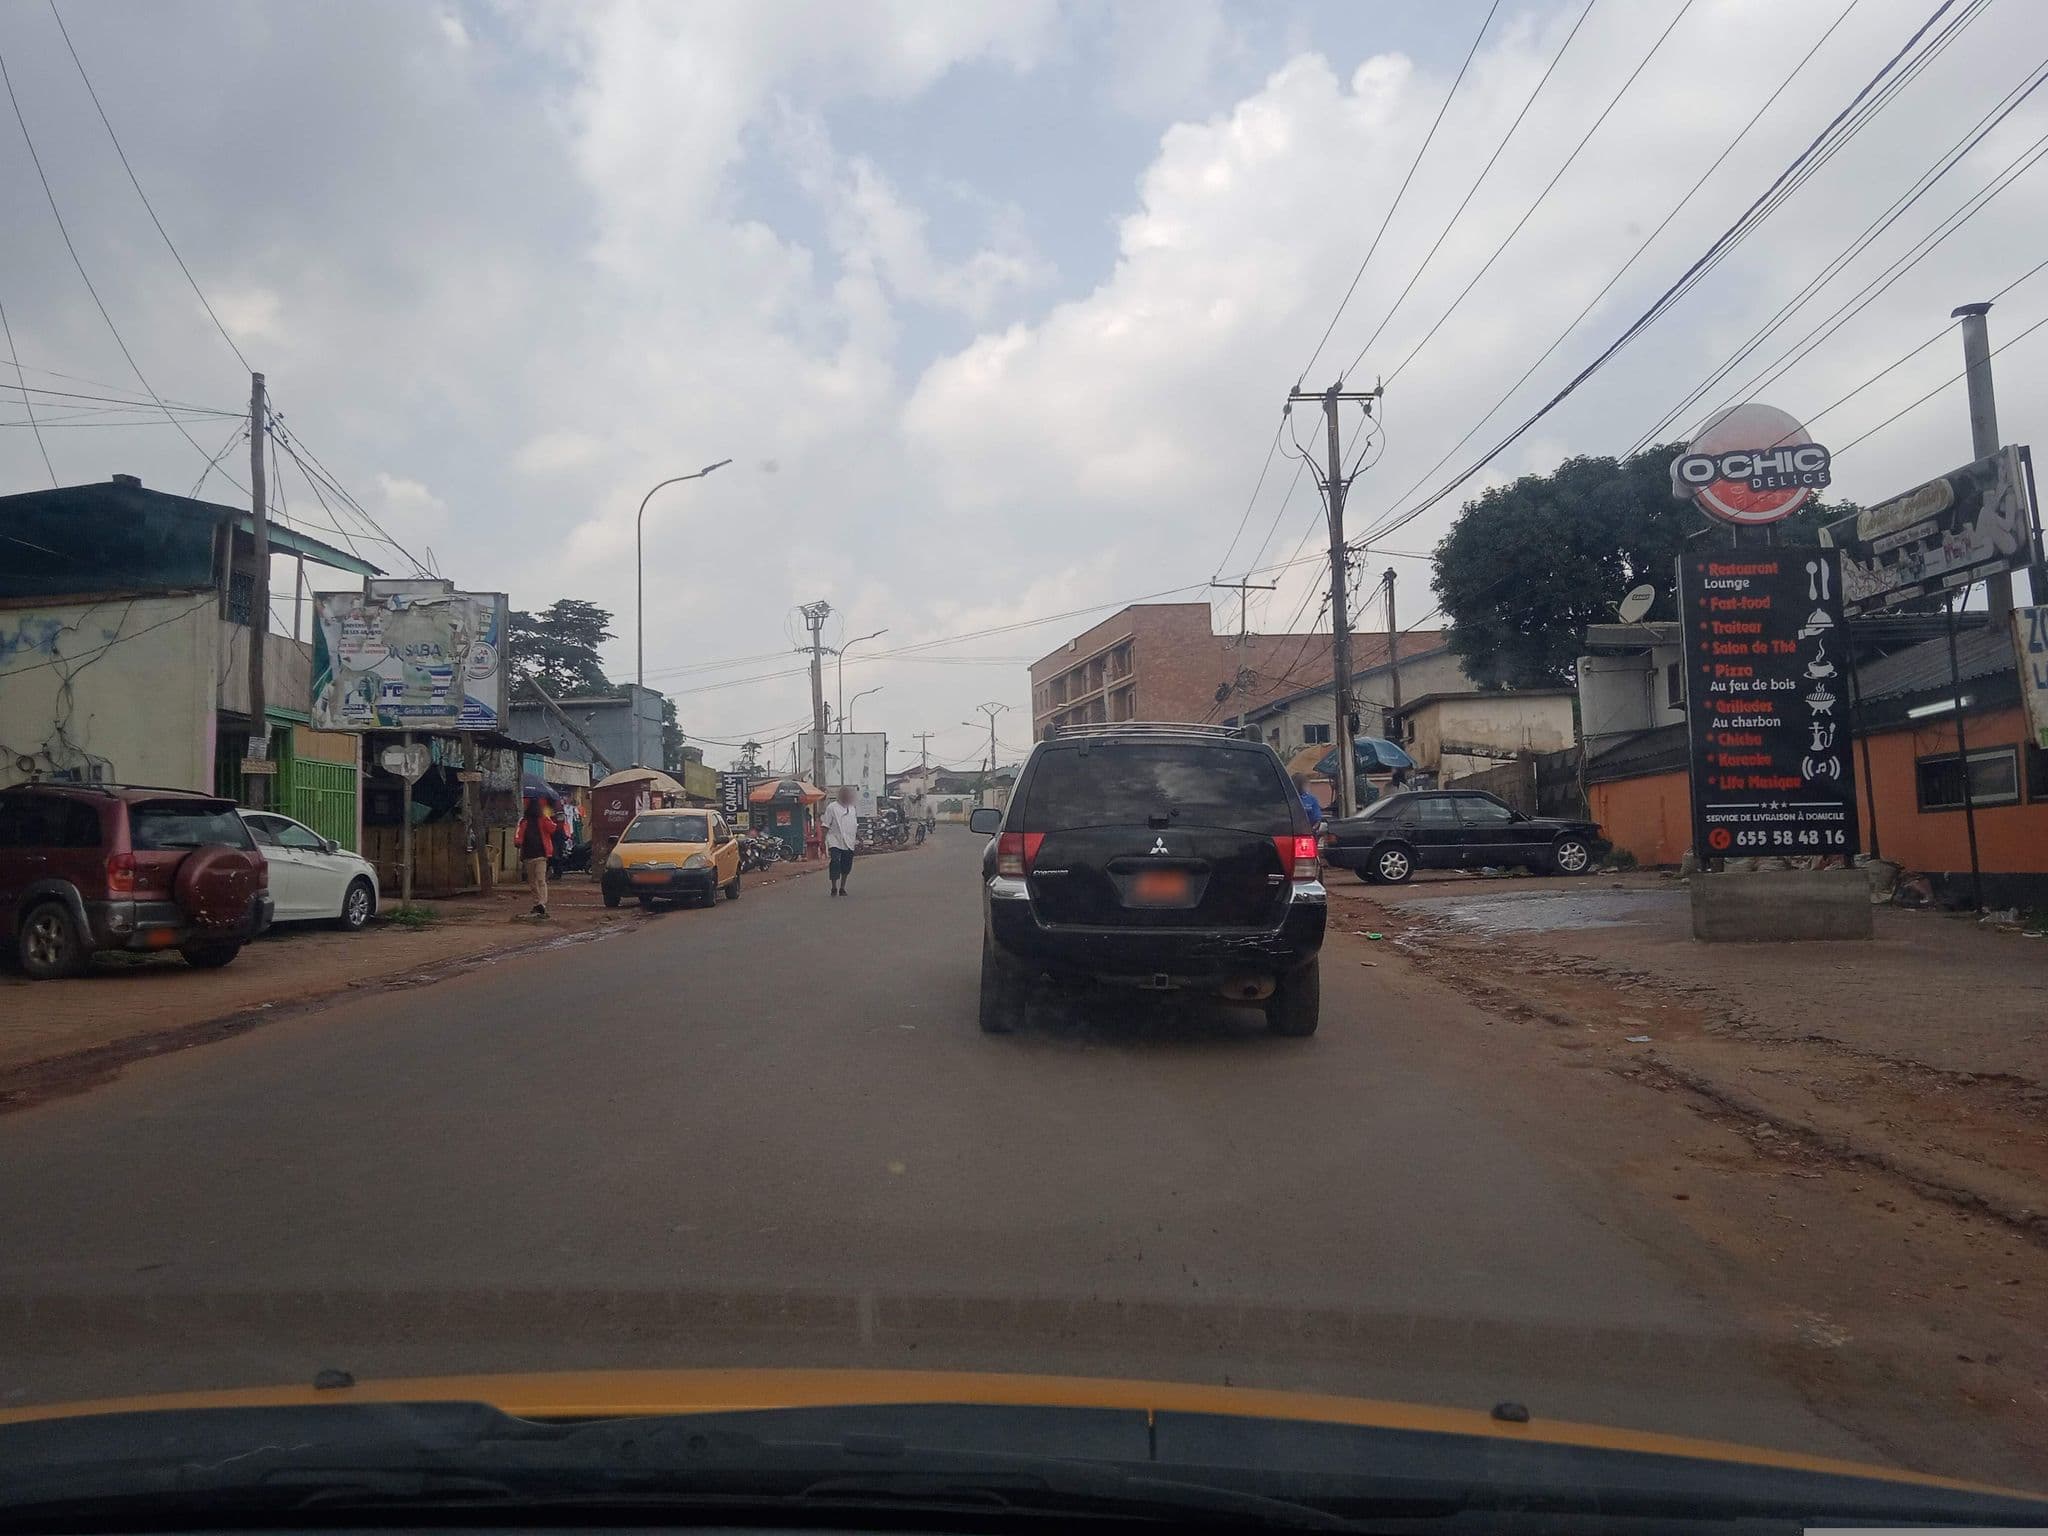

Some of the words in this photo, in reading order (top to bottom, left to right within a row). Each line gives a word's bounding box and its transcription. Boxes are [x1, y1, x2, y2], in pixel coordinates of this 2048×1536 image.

[1682, 449, 1825, 482] O'CHIC
[1709, 562, 1778, 577] Restaurant
[1704, 579, 1750, 591] Lounge
[1710, 596, 1771, 611] Fast-food
[1711, 621, 1762, 634] Traiteur
[1712, 640, 1748, 655] Salon
[1752, 641, 1768, 654] de
[1771, 639, 1797, 653] Thé
[1715, 664, 1753, 677] Pizza
[1710, 681, 1727, 692] Au
[1729, 680, 1749, 694] feu
[1752, 679, 1767, 690] de
[1771, 678, 1796, 690] bois
[1715, 699, 1773, 714] Grillades
[1712, 718, 1728, 729] Au
[1732, 716, 1781, 728] charbon
[1718, 733, 1762, 746] Chicha
[1749, 775, 1801, 790] Musique
[1706, 814, 1738, 823] SERVICE
[1740, 814, 1751, 822] DE
[1753, 812, 1796, 822] LIVRAISON
[1798, 811, 1805, 821] À
[1806, 812, 1845, 821] DOMICILE
[1736, 831, 1767, 846] 655
[1773, 830, 1793, 845] 58
[1798, 830, 1819, 845] 48
[1825, 830, 1845, 845] 16
